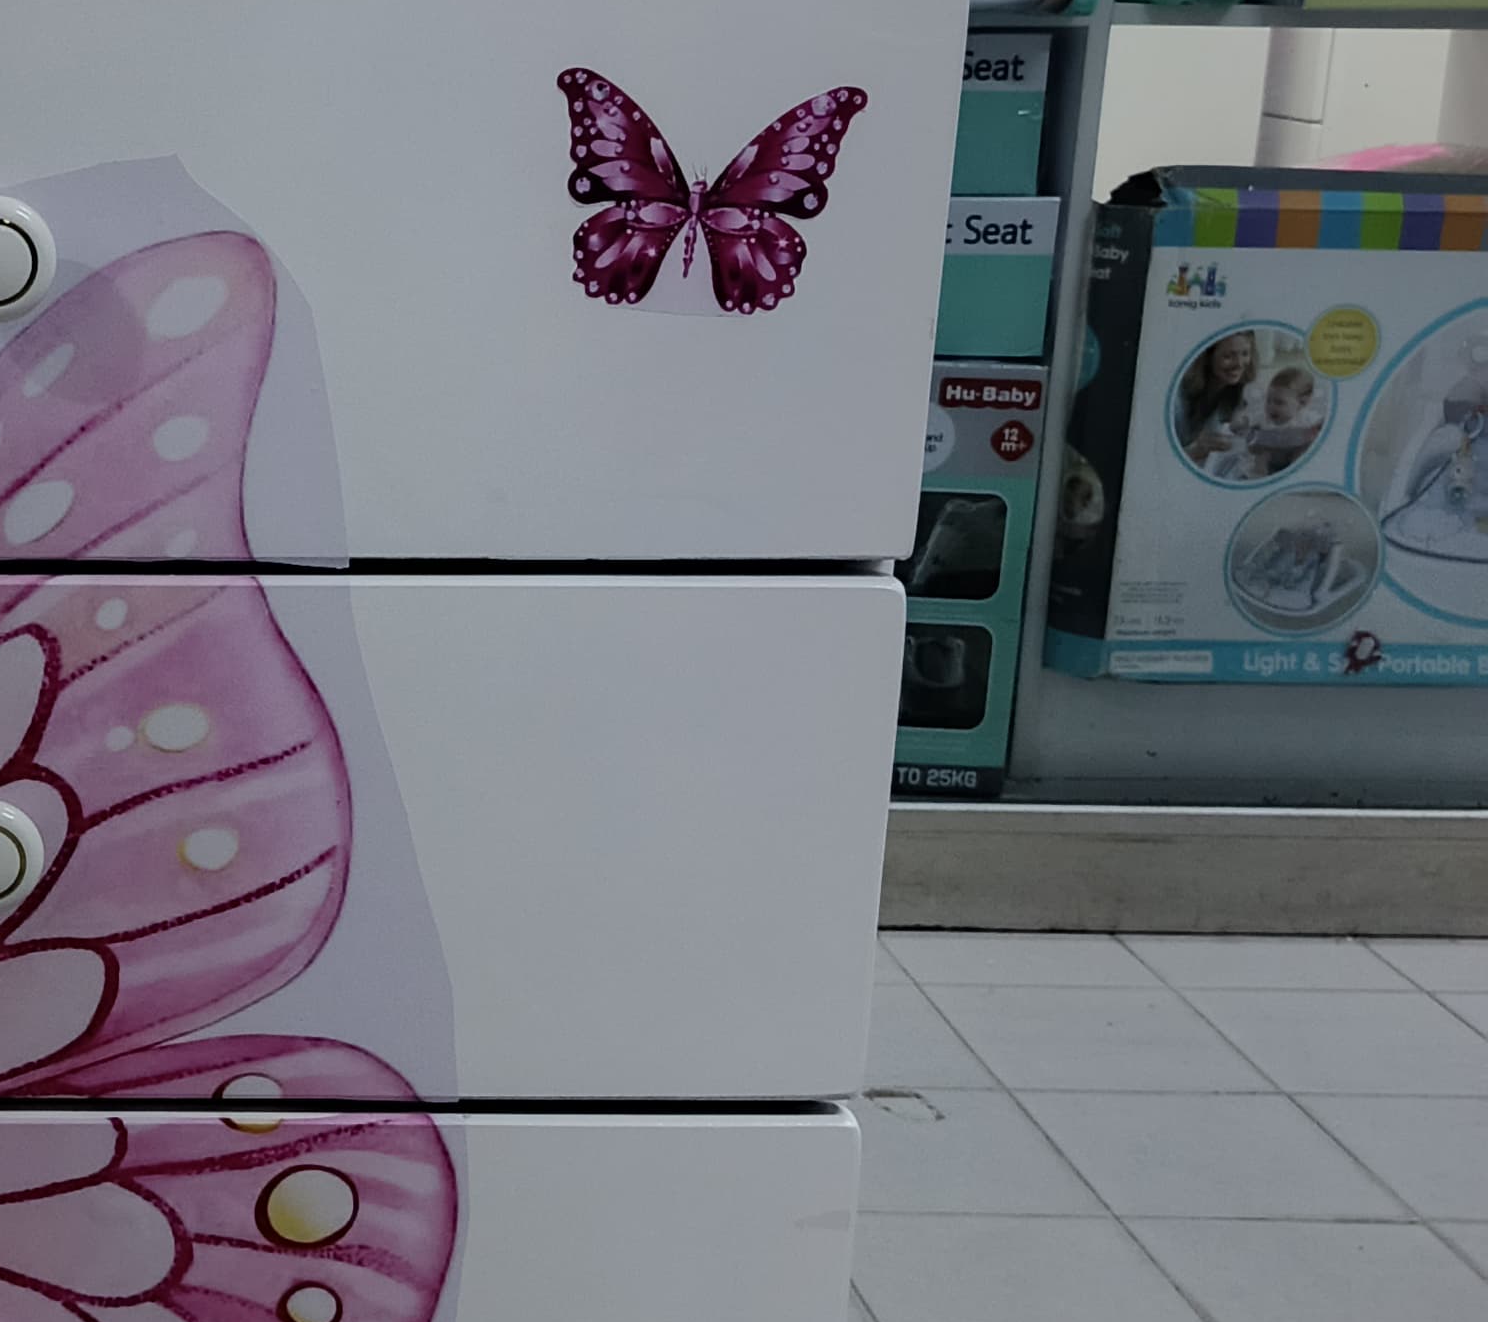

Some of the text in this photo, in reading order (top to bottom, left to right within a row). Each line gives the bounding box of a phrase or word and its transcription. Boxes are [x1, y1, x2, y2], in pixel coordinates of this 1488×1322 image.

[962, 50, 1025, 82] Seat
[963, 214, 1033, 245] Seat
[945, 384, 1037, 407] Hu-Baby
[1002, 427, 1019, 442] 12
[1242, 649, 1297, 676] Light
[1302, 651, 1321, 673] &
[1378, 651, 1471, 675] Portable
[896, 766, 977, 788] TO 25KG
